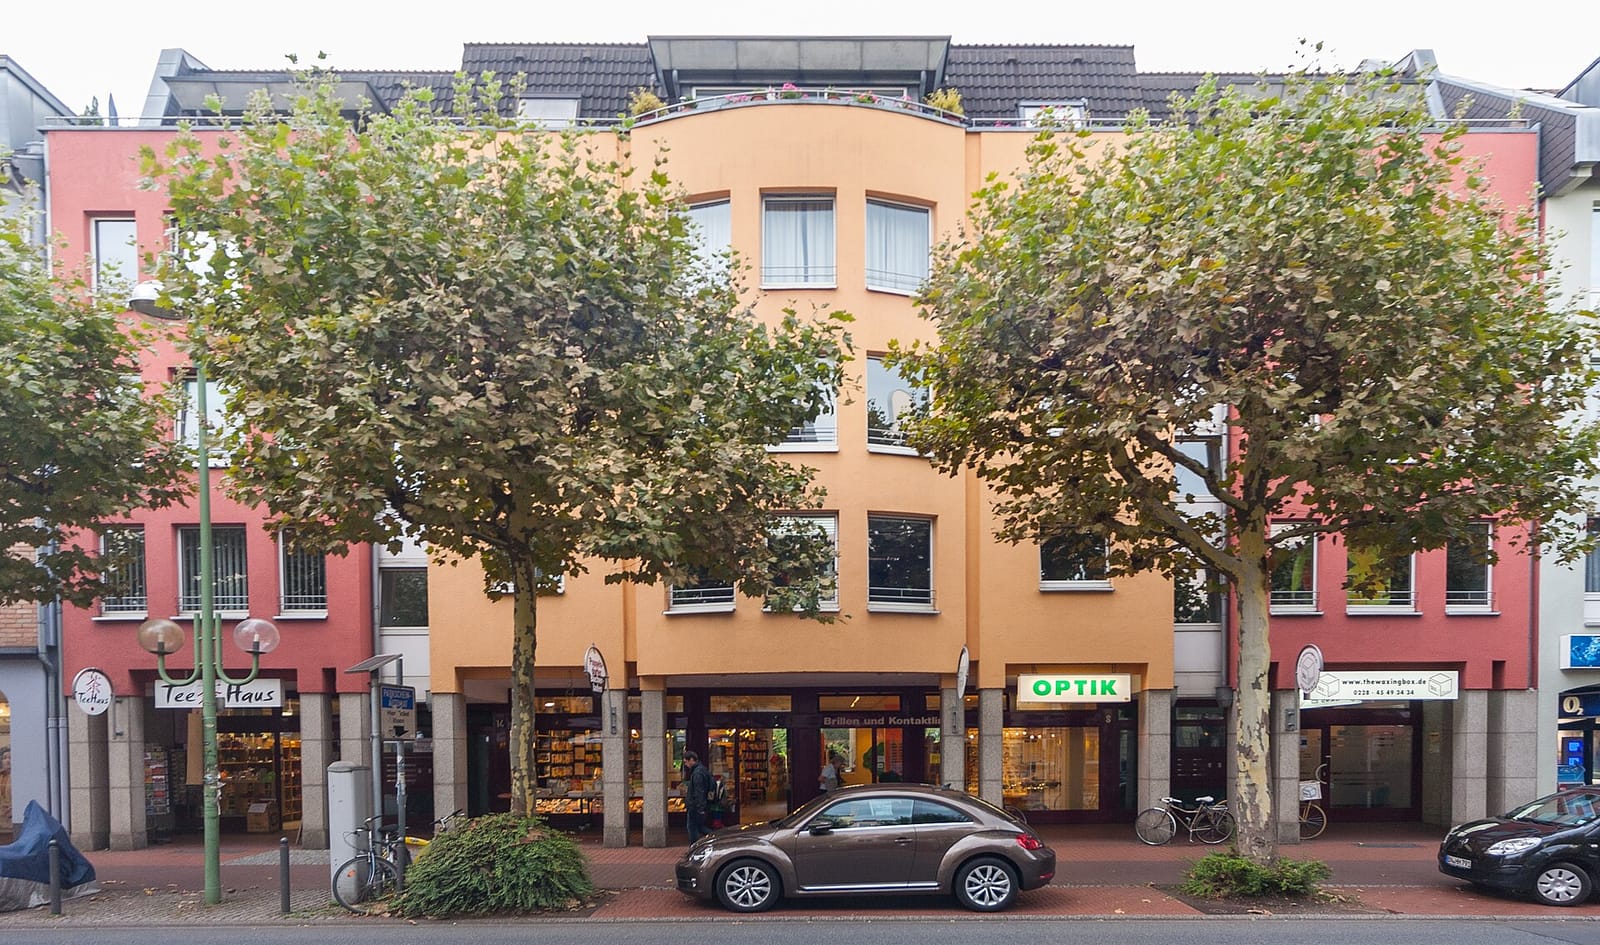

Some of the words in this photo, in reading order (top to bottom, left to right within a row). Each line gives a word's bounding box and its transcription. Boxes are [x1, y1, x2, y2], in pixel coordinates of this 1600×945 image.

[1033, 679, 1118, 697] OPTIK
[1342, 678, 1427, 686] www.thewaxingbox.de
[161, 684, 197, 703] Tee
[226, 683, 275, 703] Haus
[823, 716, 860, 726] Brillen
[863, 716, 885, 726] und
